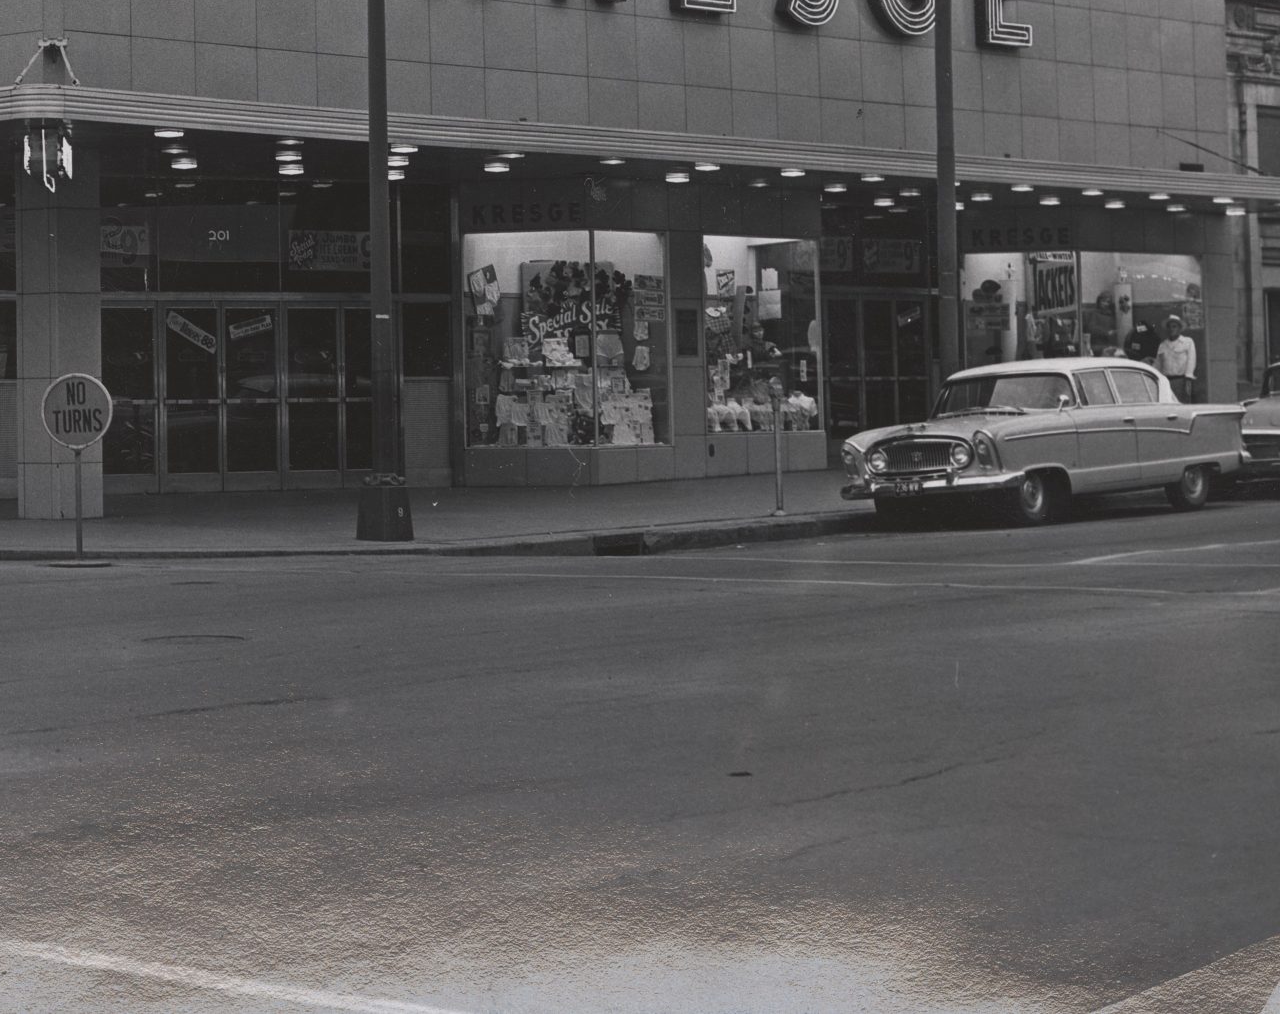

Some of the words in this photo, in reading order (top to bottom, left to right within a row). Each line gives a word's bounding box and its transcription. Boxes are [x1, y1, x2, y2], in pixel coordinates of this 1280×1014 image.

[472, 202, 582, 225] KRESGE
[208, 230, 230, 241] 201
[971, 227, 1070, 247] KRESGE
[527, 304, 577, 343] Special
[66, 381, 86, 405] NO
[52, 408, 103, 434] TURNS
[397, 507, 404, 517] 9
